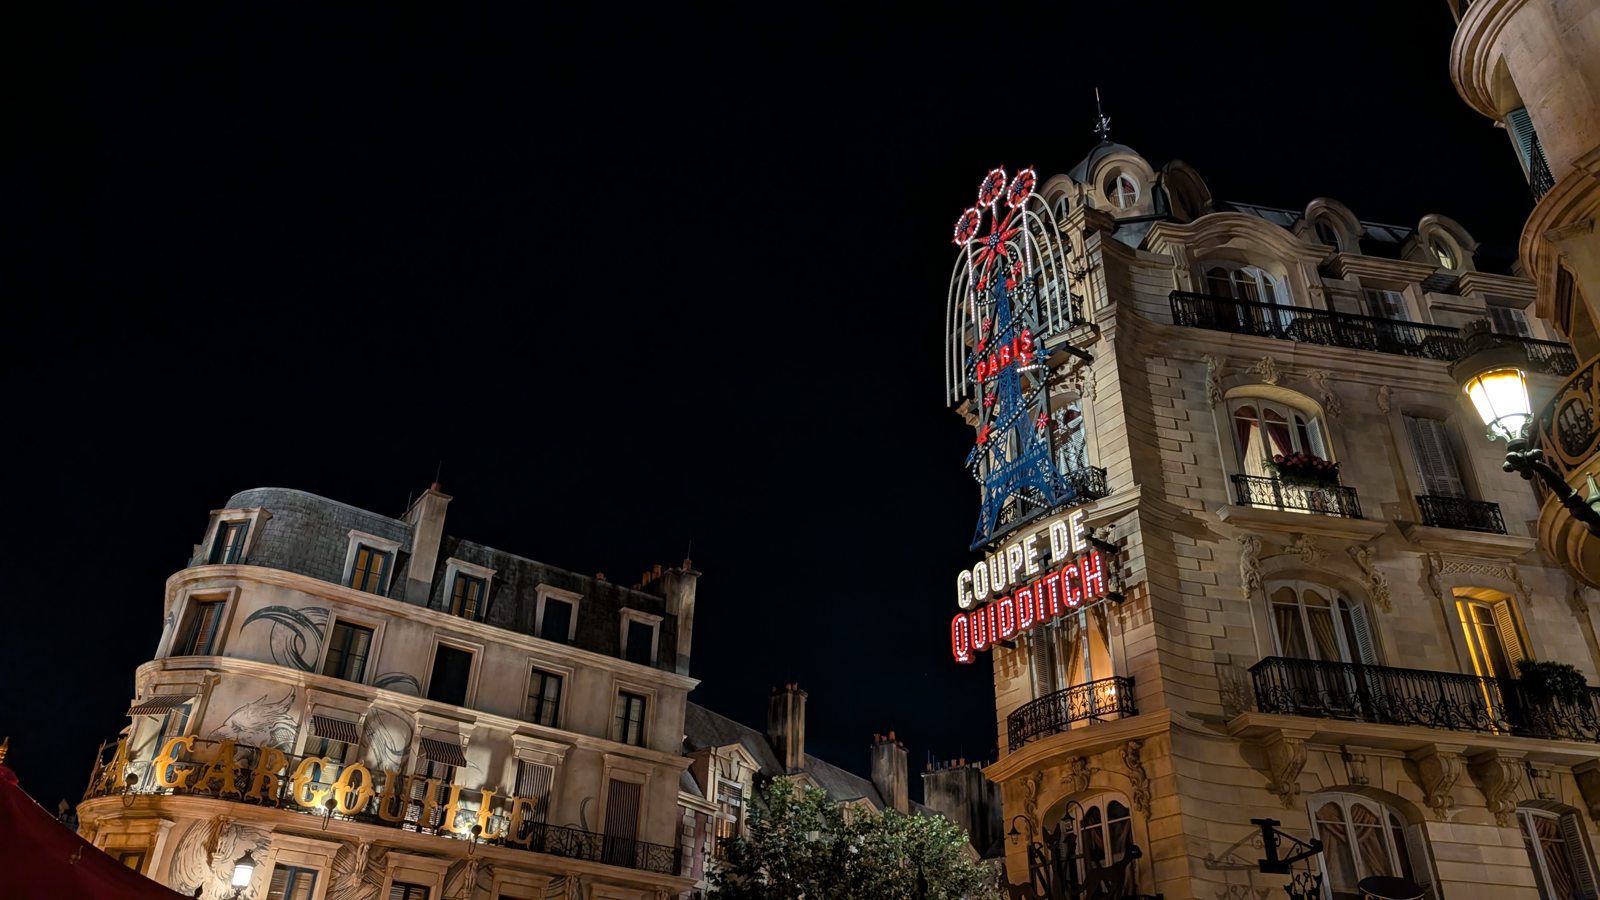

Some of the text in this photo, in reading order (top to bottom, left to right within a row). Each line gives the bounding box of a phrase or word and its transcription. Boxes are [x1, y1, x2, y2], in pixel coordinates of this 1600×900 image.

[976, 329, 1034, 383] PARIS
[952, 551, 1104, 664] QUIDDITCH
[957, 508, 1088, 609] COUPE DE
[152, 734, 538, 850] GARGOUILLE
